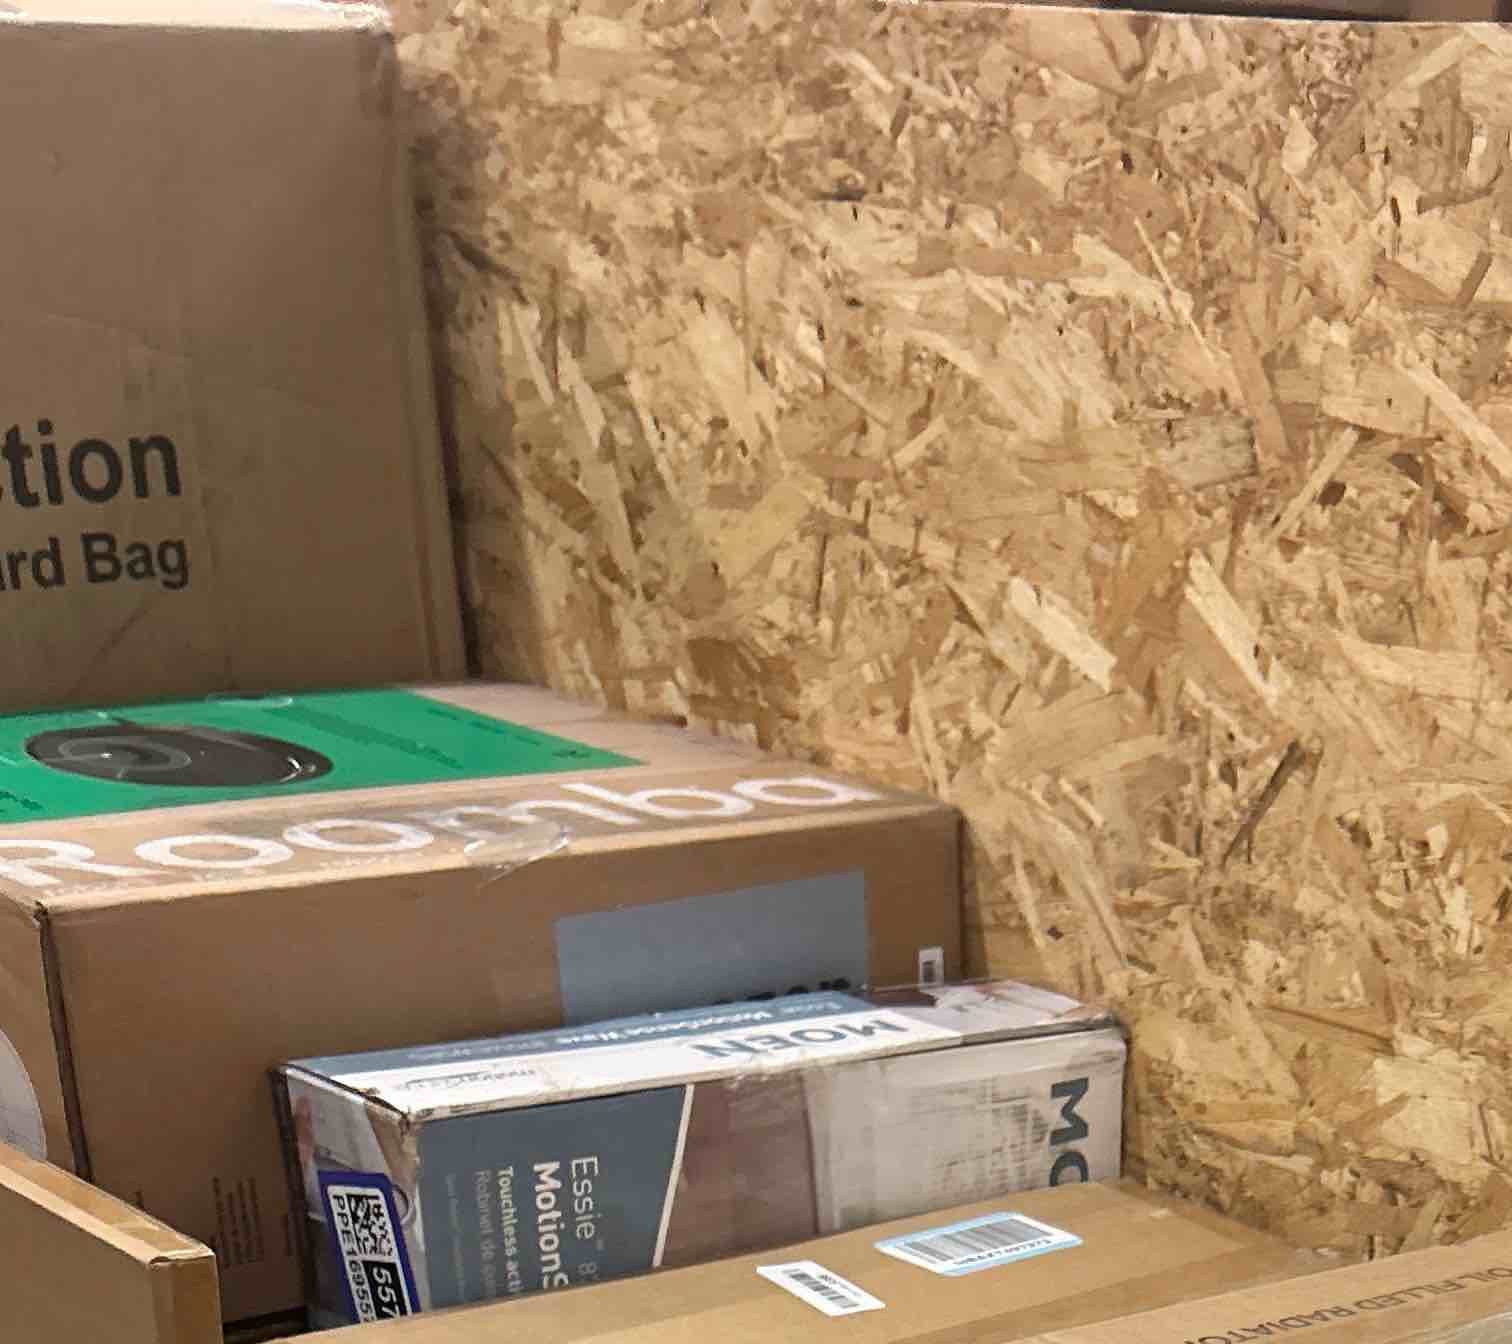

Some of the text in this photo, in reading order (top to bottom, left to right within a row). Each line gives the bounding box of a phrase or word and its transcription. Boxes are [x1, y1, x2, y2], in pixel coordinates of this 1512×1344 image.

[0, 418, 182, 507] tion
[0, 532, 190, 590] rd Bag
[0, 774, 885, 889] Roomba
[1049, 1077, 1089, 1187] MO
[498, 1166, 524, 1293] Touchless acti
[534, 1160, 569, 1289] MotionS
[571, 1155, 603, 1240] Essie
[333, 1195, 377, 1322] PPE16955
[373, 1267, 401, 1318] 557
[1357, 1280, 1467, 1314] FILLED
